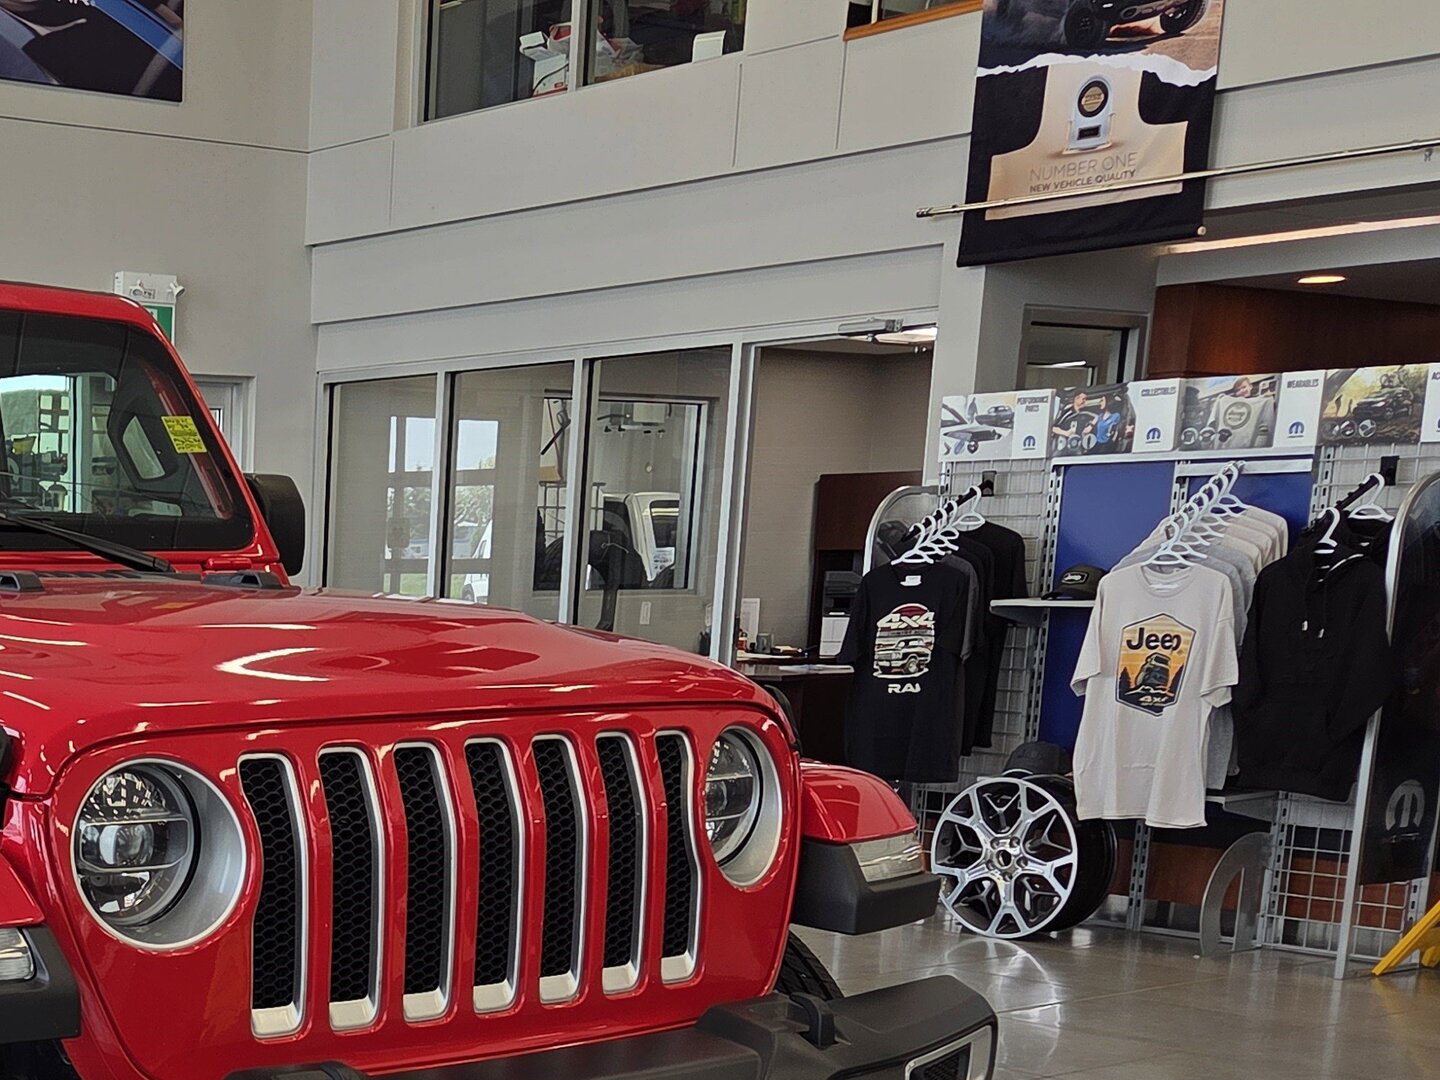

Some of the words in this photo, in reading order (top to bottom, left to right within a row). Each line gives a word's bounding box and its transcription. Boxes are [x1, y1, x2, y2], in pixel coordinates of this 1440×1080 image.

[1029, 160, 1097, 181] NUMBER
[1102, 152, 1139, 170] ONE
[1029, 182, 1051, 193] NEW
[1054, 176, 1092, 189] VEHICLE
[1095, 168, 1136, 184] QUALITY
[1141, 386, 1177, 397] COLLECTIBLES
[1287, 378, 1319, 389] WEARABLES
